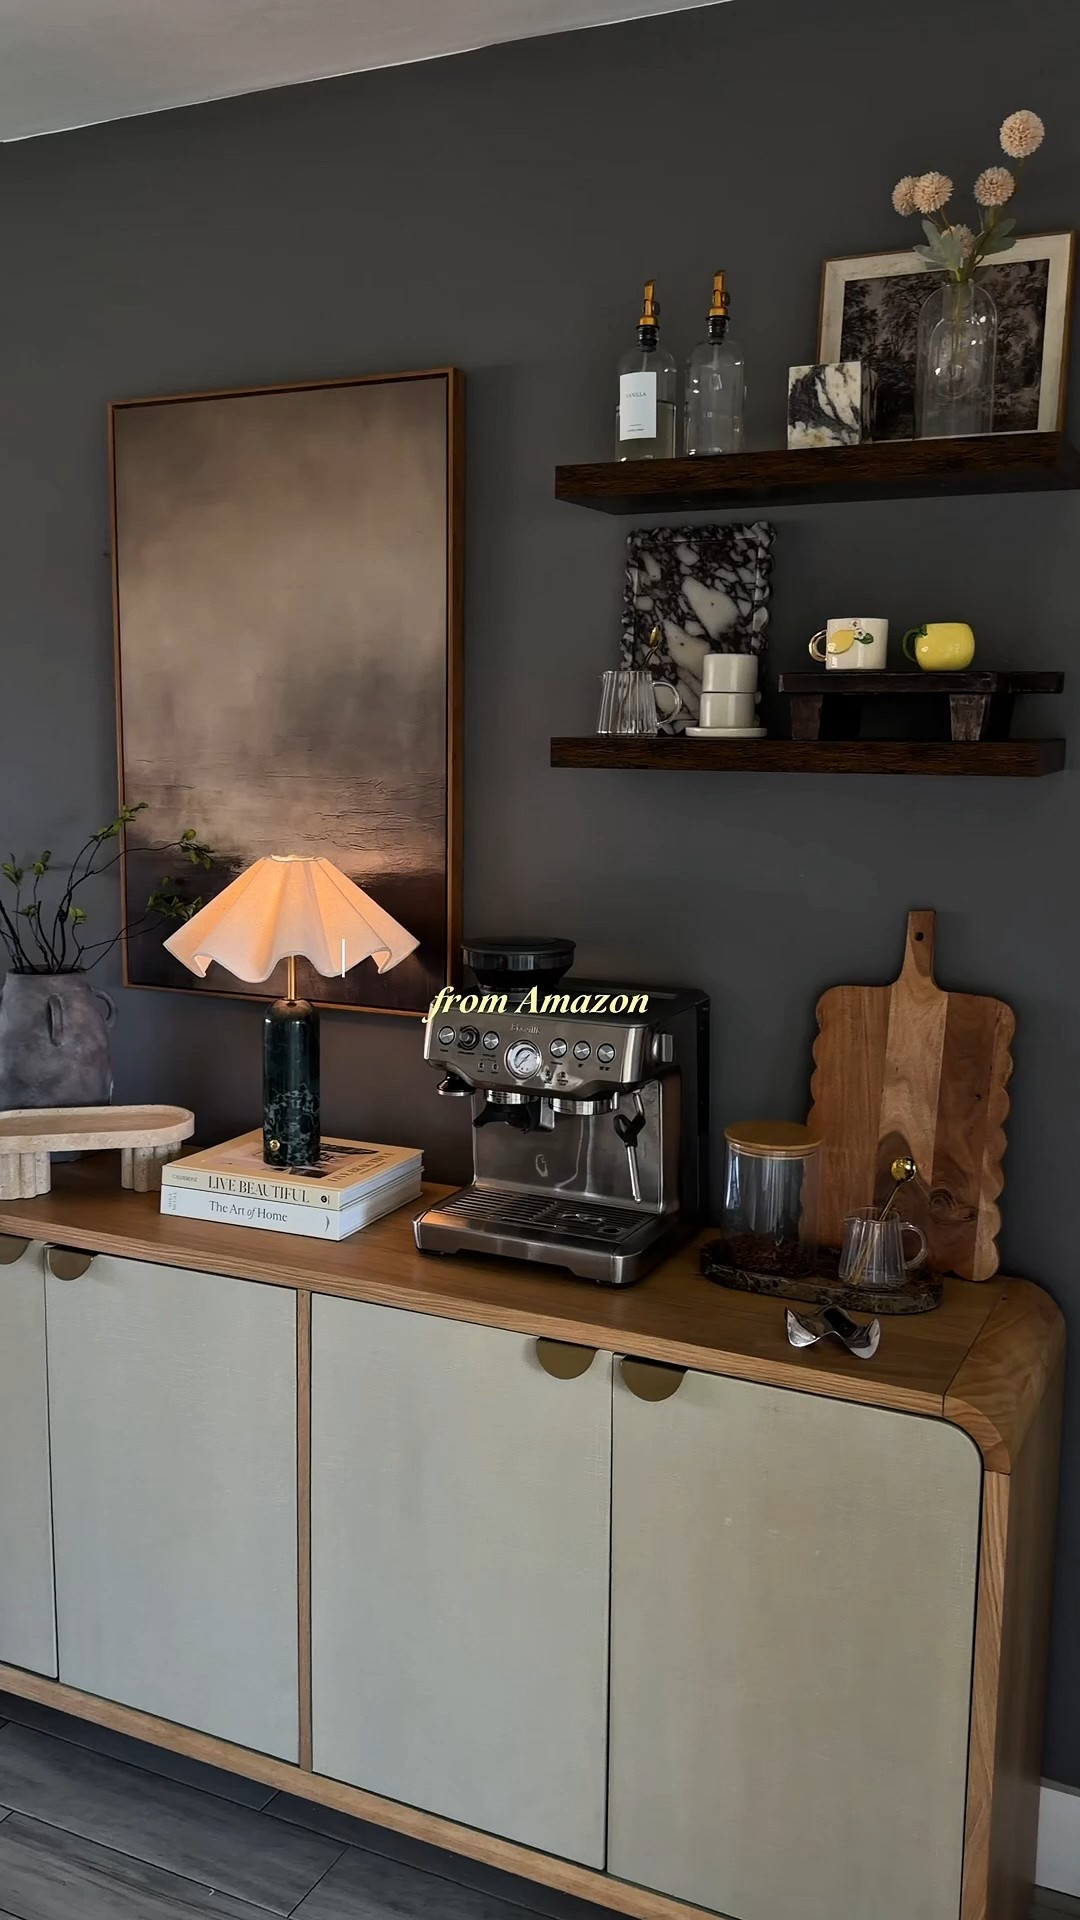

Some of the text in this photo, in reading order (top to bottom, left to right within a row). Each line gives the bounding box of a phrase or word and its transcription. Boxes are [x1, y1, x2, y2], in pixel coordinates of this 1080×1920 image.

[208, 1175, 236, 1192] LIVE
[239, 1180, 310, 1203] BEAUTIFUL
[208, 1200, 288, 1222] The Art of Home
